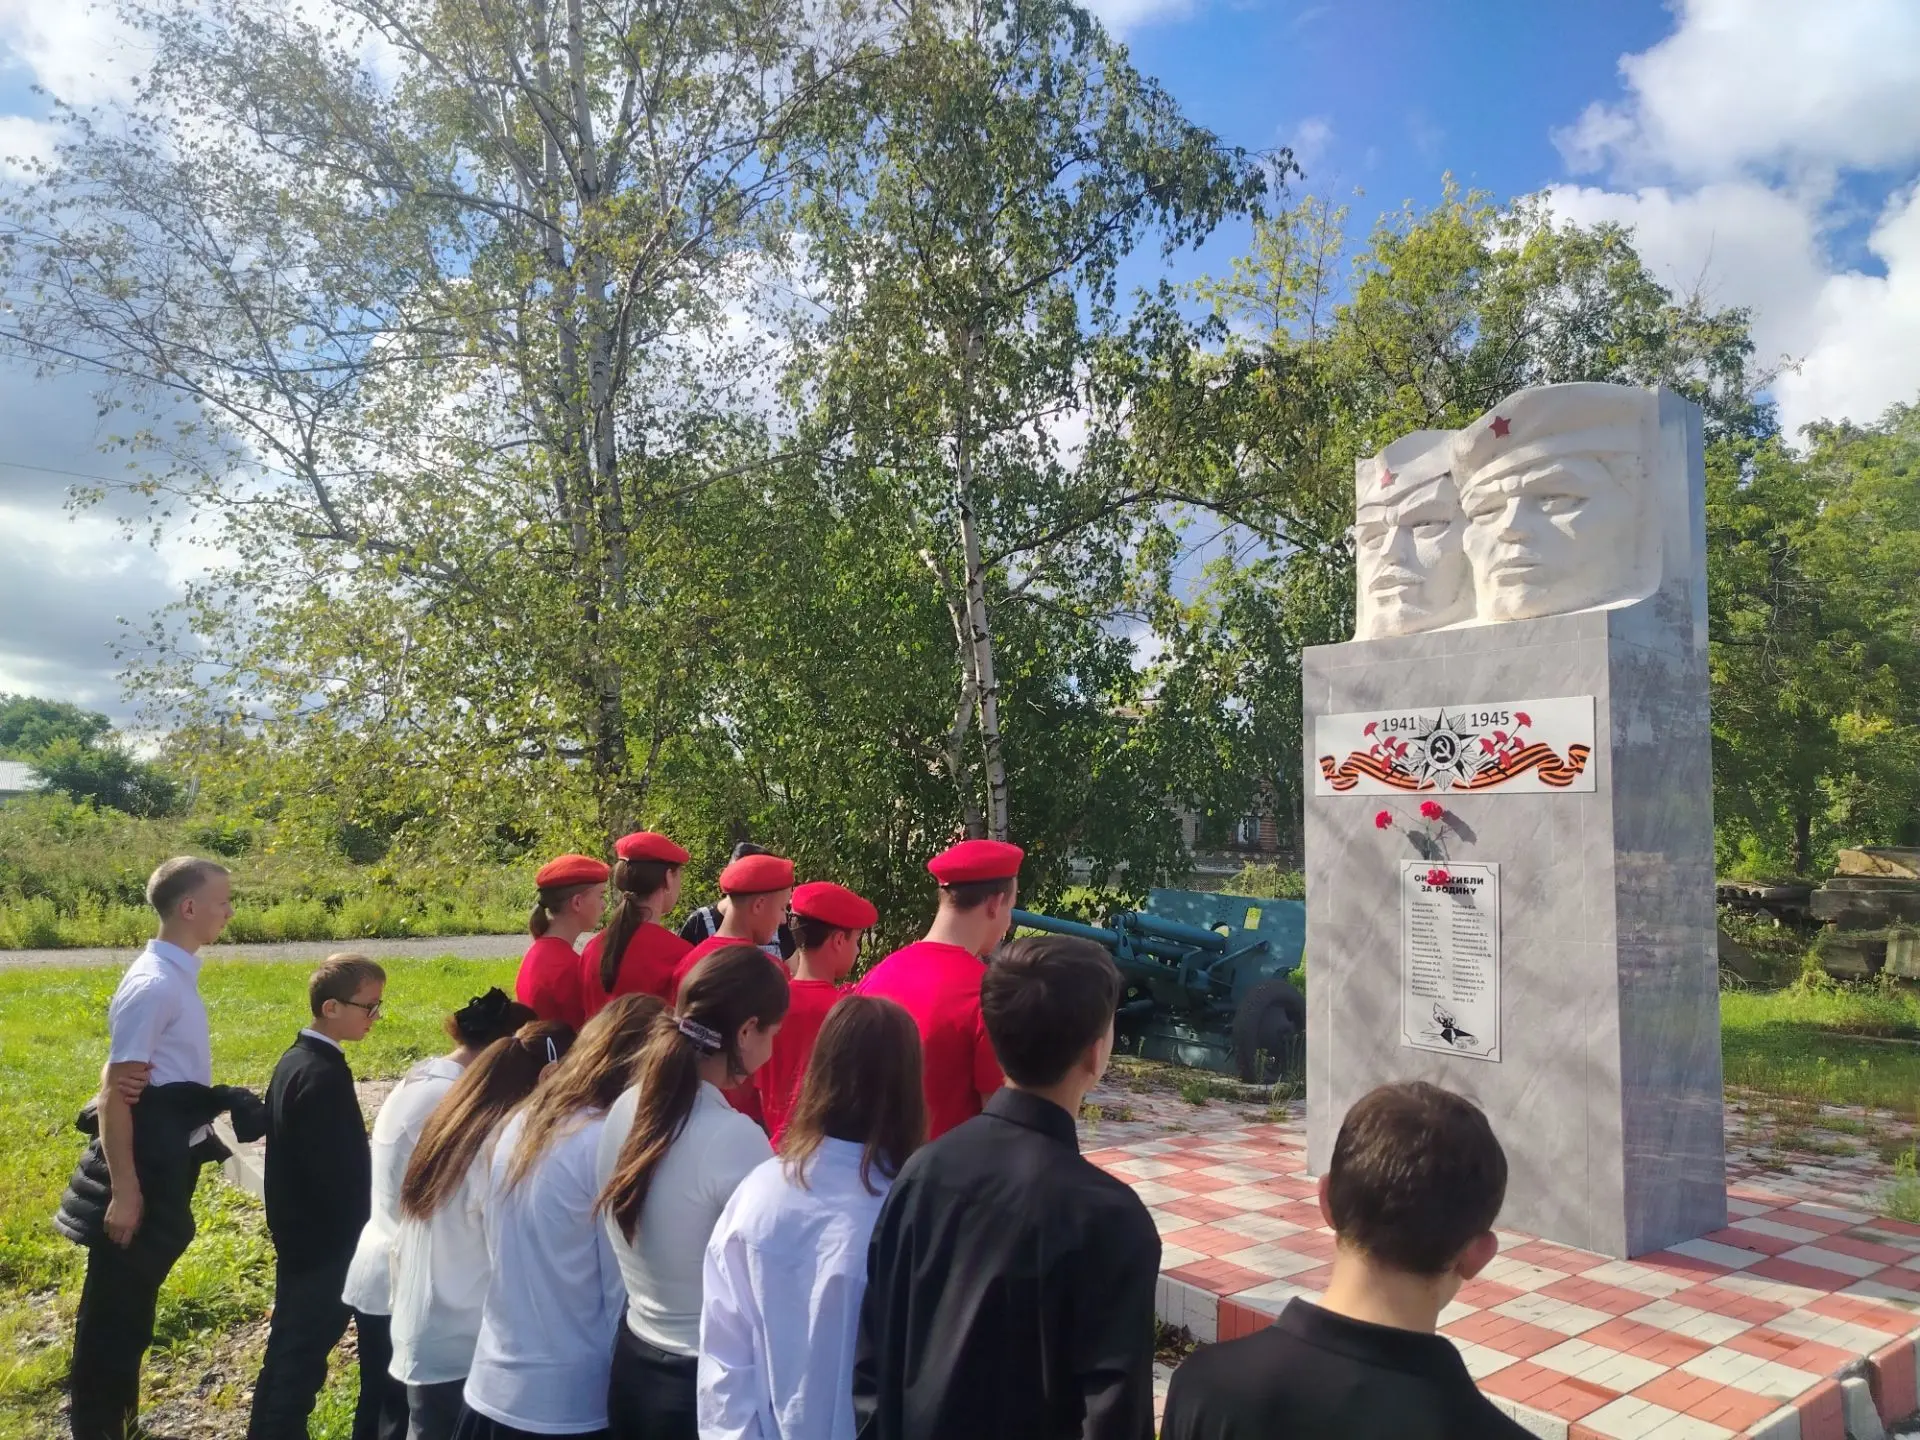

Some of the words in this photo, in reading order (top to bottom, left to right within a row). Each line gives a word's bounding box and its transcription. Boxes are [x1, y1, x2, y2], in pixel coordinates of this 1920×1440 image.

[1382, 716, 1416, 732] 1941
[1471, 711, 1509, 727] 1945
[1414, 874, 1433, 882] ОН
[1440, 875, 1484, 885] ОГИБЛИ
[1421, 885, 1432, 893] ЗА
[1436, 886, 1477, 895] РОДИНУ
